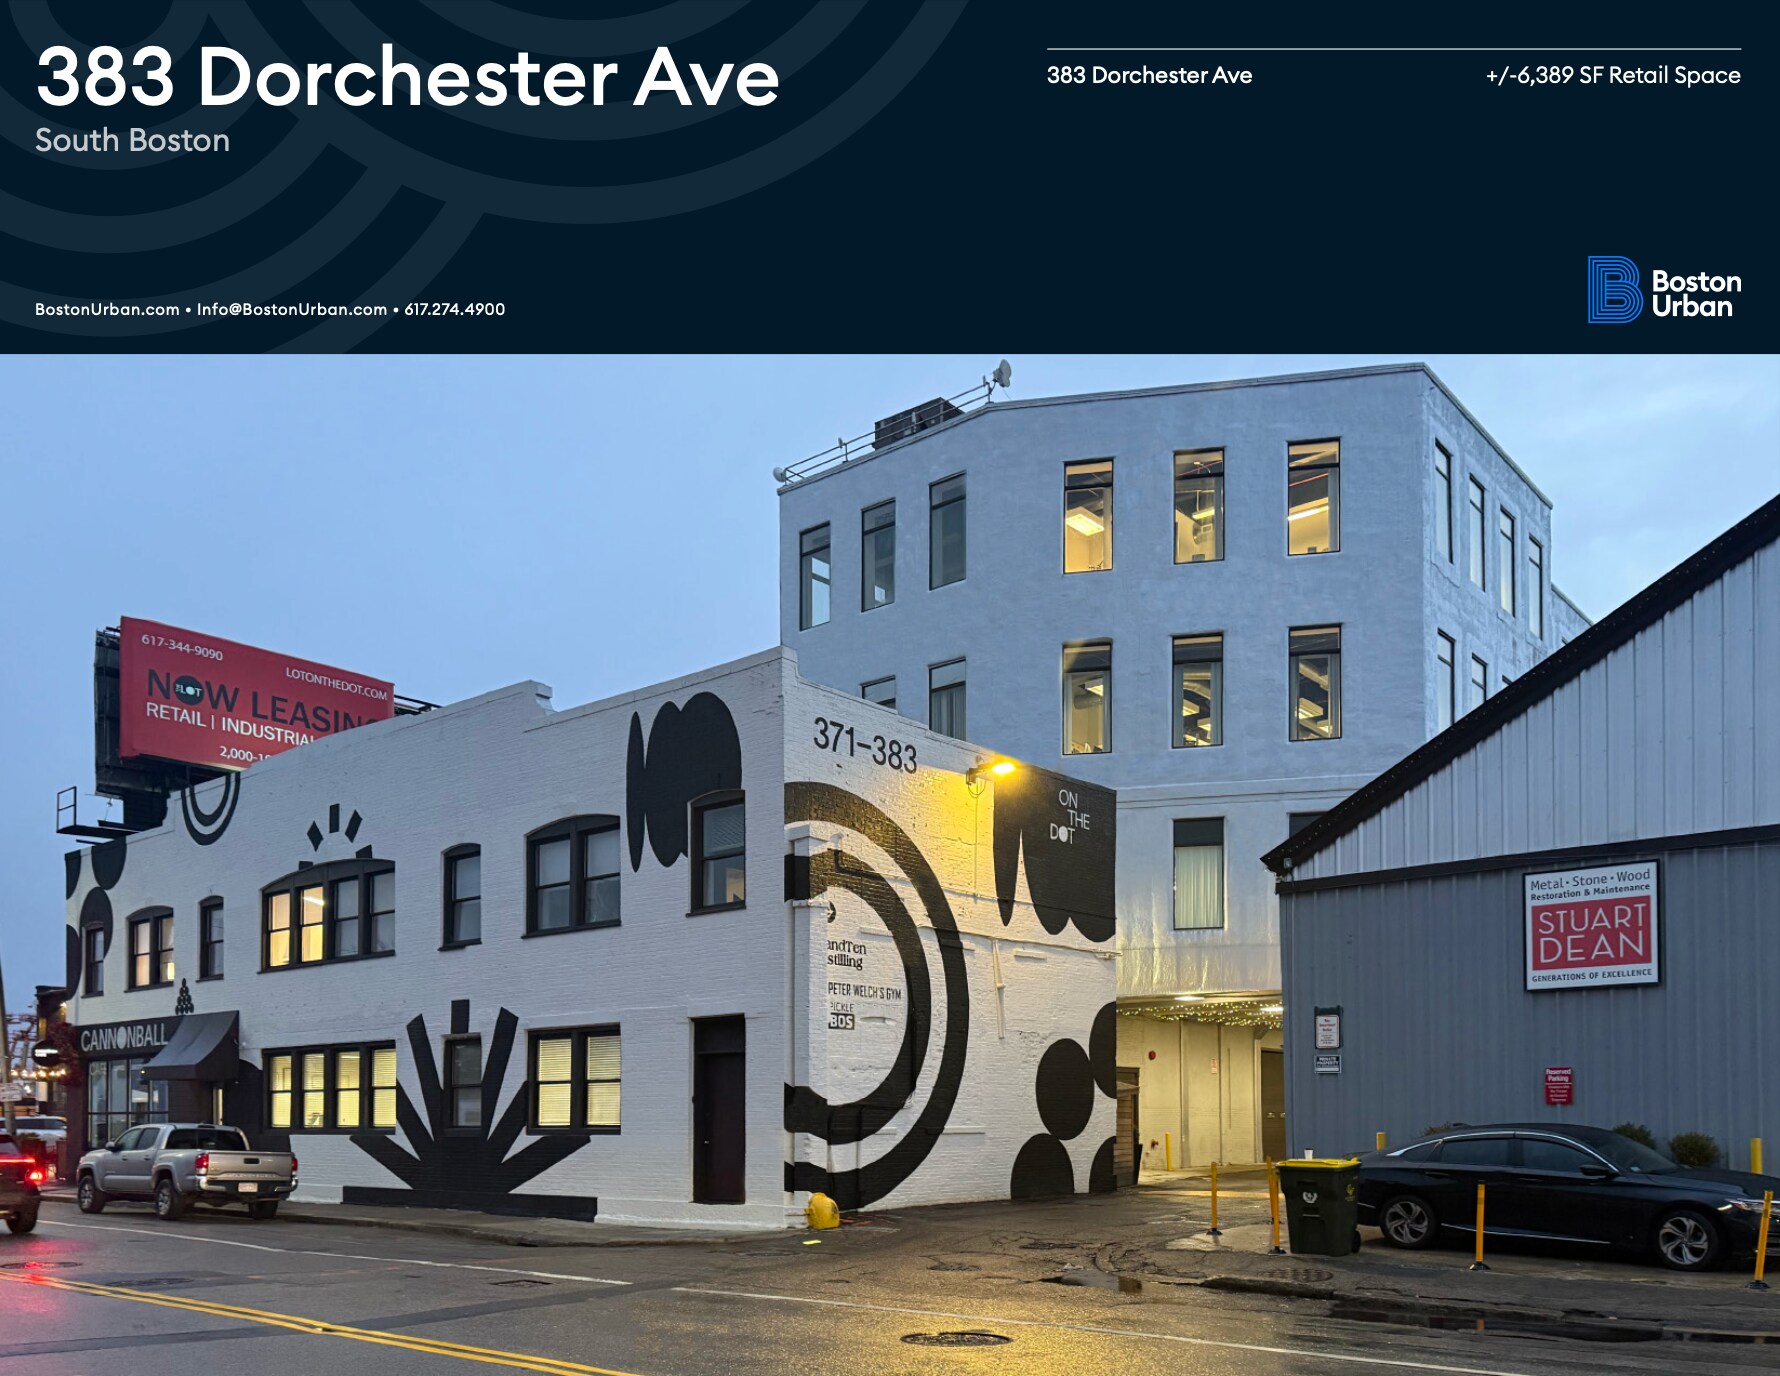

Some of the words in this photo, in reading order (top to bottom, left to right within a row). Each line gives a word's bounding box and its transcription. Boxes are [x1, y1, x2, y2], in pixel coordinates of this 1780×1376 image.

[141, 634, 224, 661] 617-344-9090
[285, 666, 389, 701] LOTONTHEDOT.COM
[146, 701, 208, 728] RETAIL
[251, 690, 379, 733] LEASIN
[813, 716, 918, 775] 371-383
[1059, 789, 1079, 809] ON
[1067, 809, 1090, 831] THE
[1050, 822, 1076, 845] DOT
[1530, 877, 1564, 891] Metal
[1572, 875, 1608, 888] Stone
[1616, 868, 1651, 883] Wood
[1530, 889, 1581, 901] Restoration
[1584, 888, 1591, 896] &
[1593, 883, 1651, 895] Maintenance
[1538, 903, 1647, 935] STUART
[1539, 930, 1643, 963] DEAN
[1532, 973, 1587, 983] GENERATIONS
[1588, 972, 1600, 980] OF
[1602, 968, 1653, 979] EXCELLENCE
[828, 981, 851, 997] PETER
[852, 984, 885, 1000] WELCH'S
[886, 987, 902, 1001] GYM
[830, 1014, 854, 1028] BOS
[80, 1022, 169, 1053] CANNONBALL
